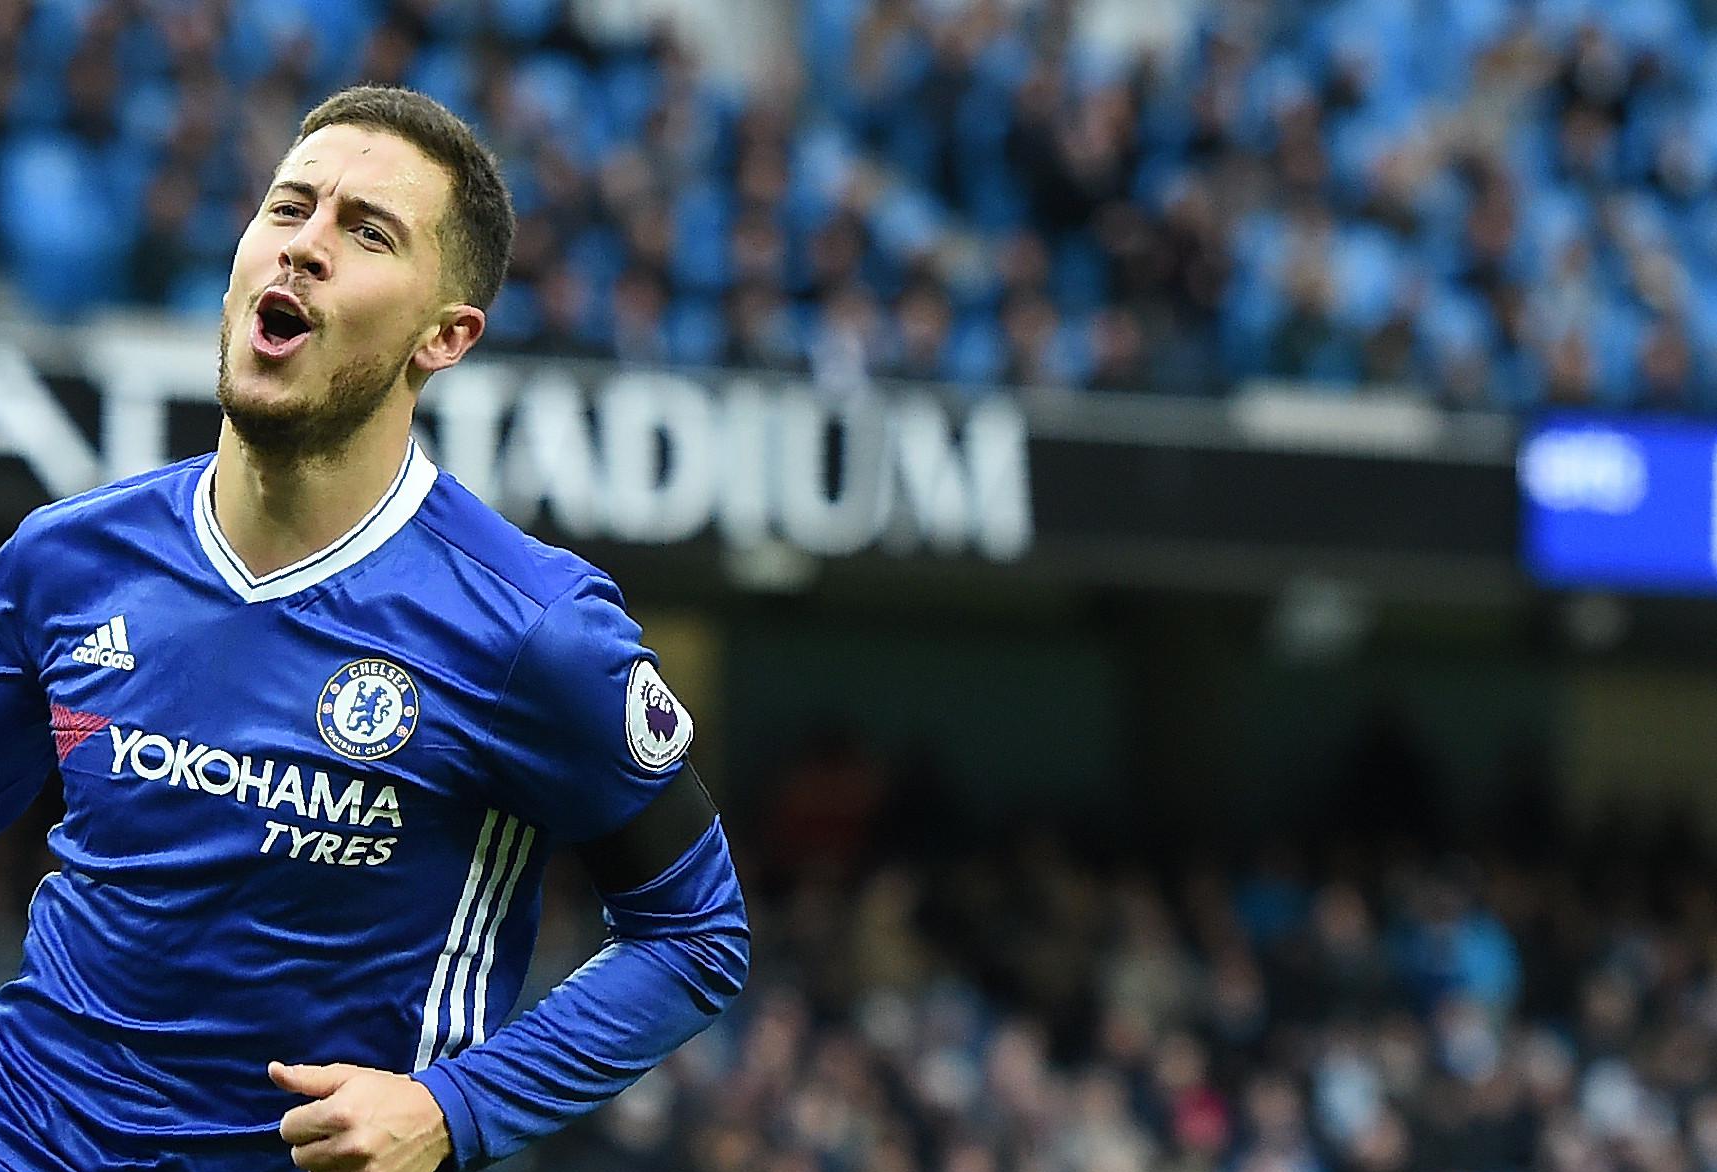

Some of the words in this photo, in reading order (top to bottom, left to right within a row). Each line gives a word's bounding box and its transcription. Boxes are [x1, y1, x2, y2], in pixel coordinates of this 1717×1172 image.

[412, 362, 1034, 562] TADIUM
[71, 645, 135, 671] adidas
[348, 663, 409, 694] CHELSEA
[325, 725, 361, 755] FOOTBALL
[364, 742, 389, 755] CLUB
[109, 724, 403, 828] YOKOHAMA
[260, 820, 397, 866] TYRES
